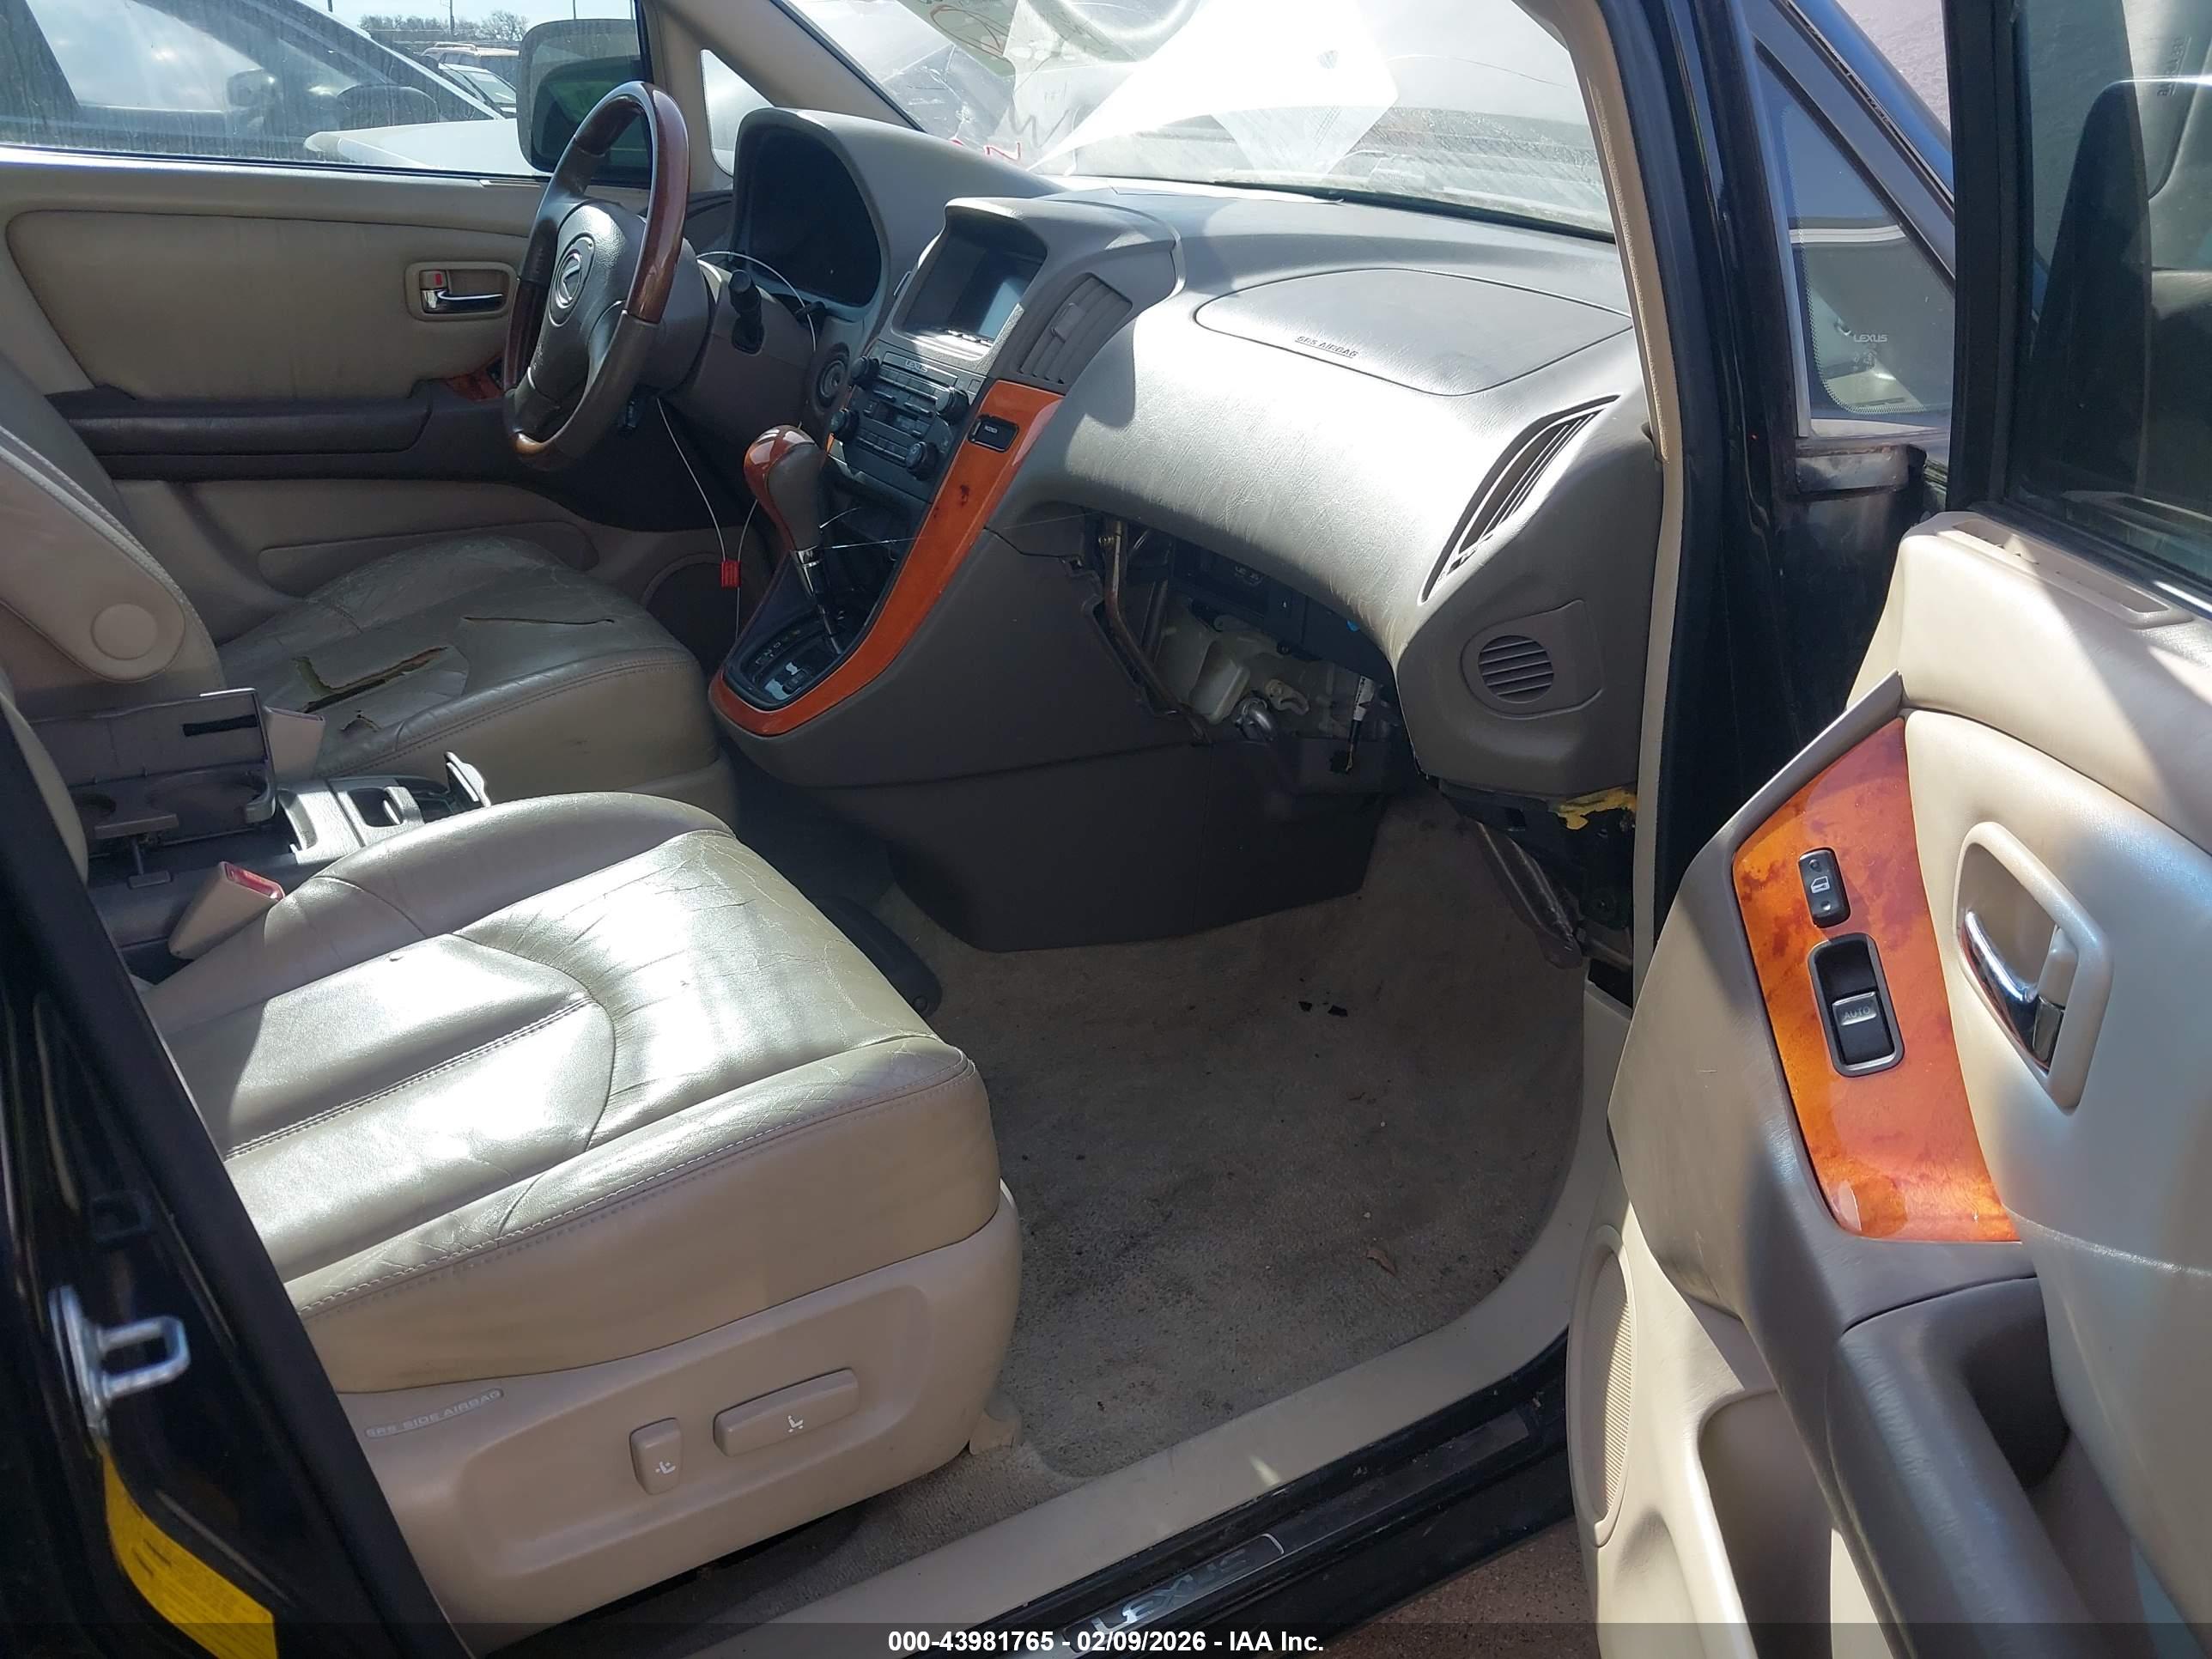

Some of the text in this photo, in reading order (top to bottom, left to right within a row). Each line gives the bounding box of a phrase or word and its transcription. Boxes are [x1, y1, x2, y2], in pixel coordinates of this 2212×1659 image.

[1296, 336, 1359, 357] SRS AIRBAG
[1853, 334, 1889, 343] LEXUS
[1844, 1006, 1870, 1020] AUTO
[403, 1413, 441, 1431] SIDE
[443, 1389, 501, 1418] AIRBAG
